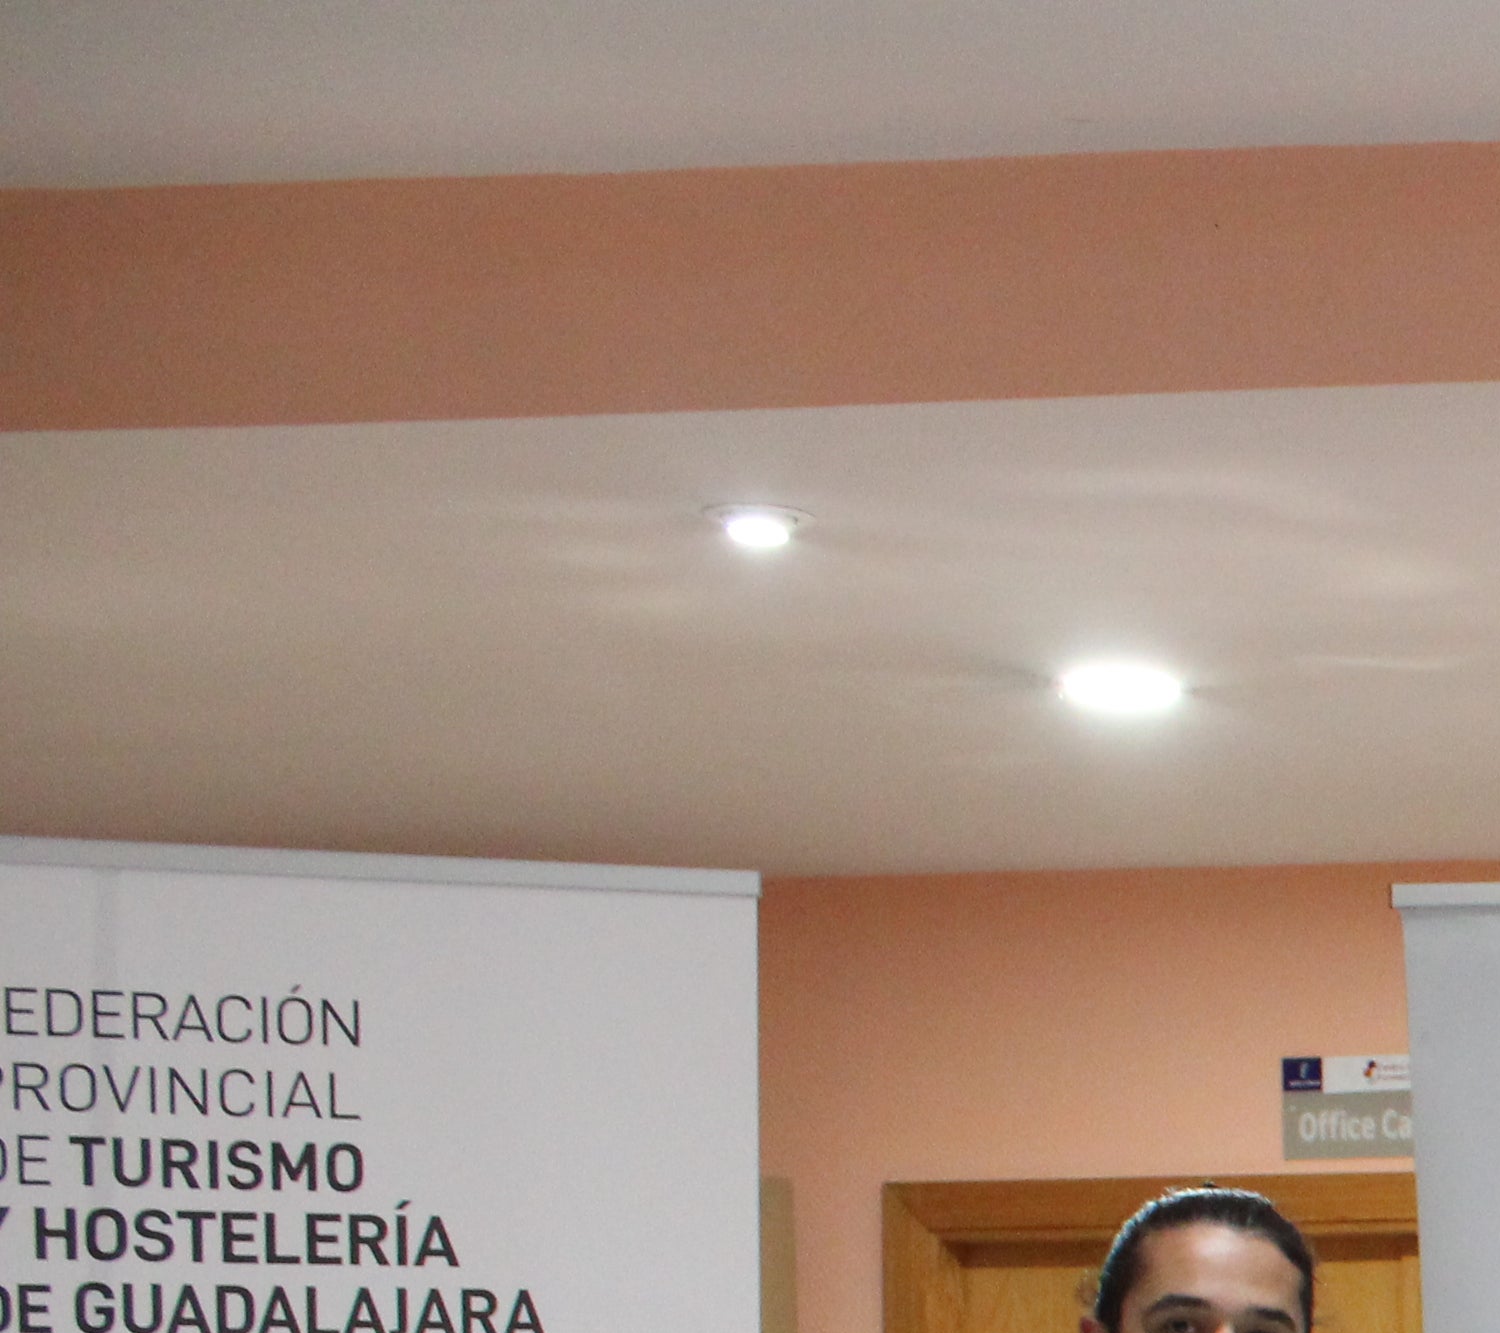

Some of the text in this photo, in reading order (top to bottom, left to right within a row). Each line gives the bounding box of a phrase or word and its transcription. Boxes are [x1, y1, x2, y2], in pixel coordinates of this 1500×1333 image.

[0, 1062, 362, 1121] ROVINCIAL
[1299, 1109, 1377, 1143] Office
[0, 1134, 366, 1193] E TURISMO
[33, 1201, 460, 1268] HOSTELERÍA
